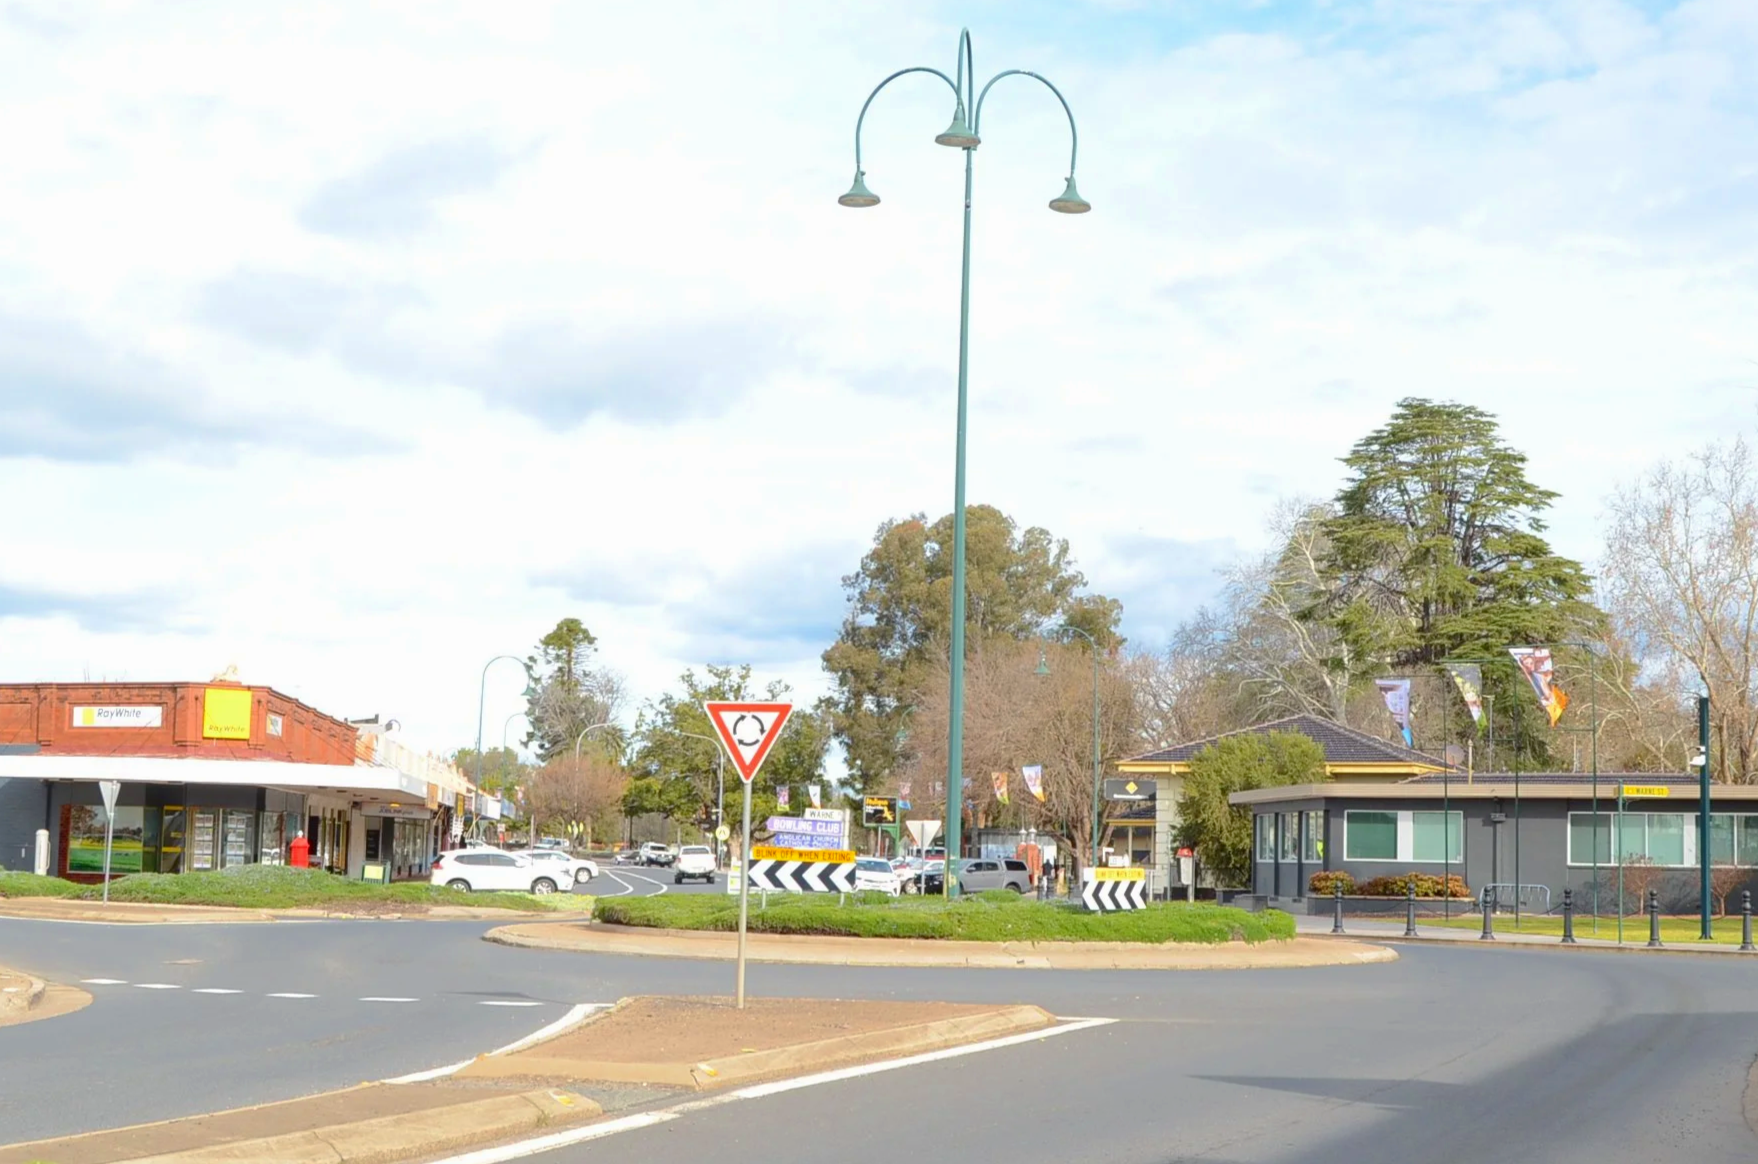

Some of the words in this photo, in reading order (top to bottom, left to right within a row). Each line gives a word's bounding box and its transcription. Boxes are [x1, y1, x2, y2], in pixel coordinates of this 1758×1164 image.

[809, 811, 834, 819] WARNE
[774, 819, 813, 831] BOWLING
[816, 822, 840, 834] CLUB
[756, 849, 777, 858] BLINK
[780, 850, 794, 859] OFF
[798, 851, 819, 860] WHEN
[822, 852, 851, 862] EXITING
